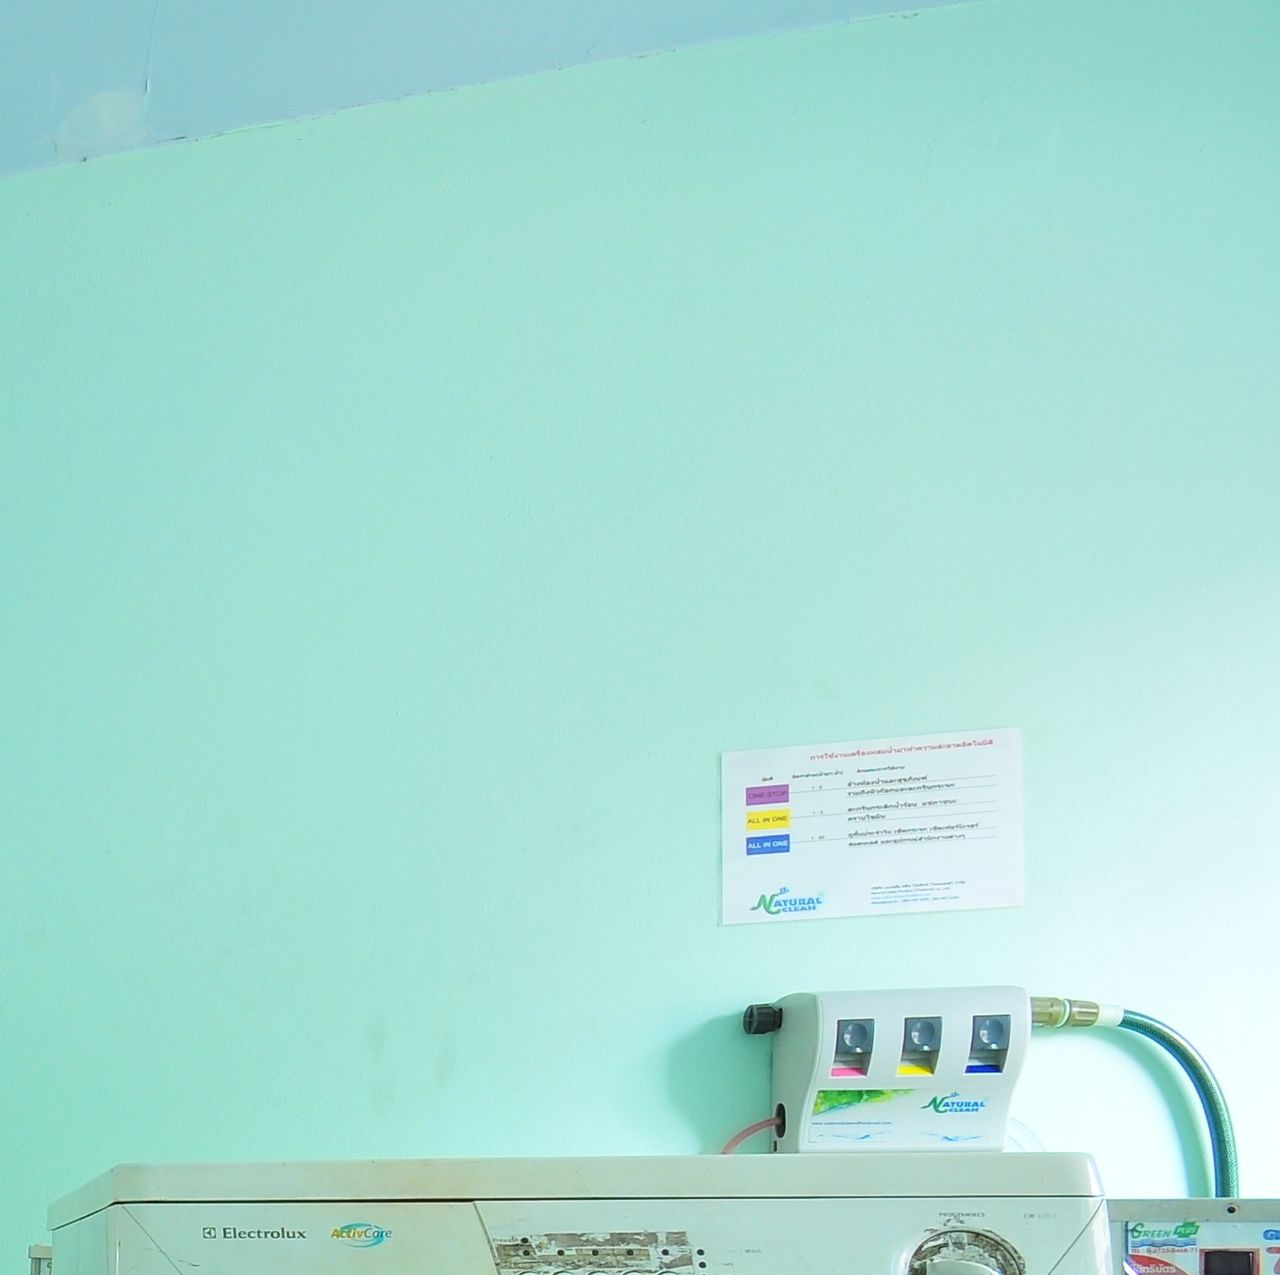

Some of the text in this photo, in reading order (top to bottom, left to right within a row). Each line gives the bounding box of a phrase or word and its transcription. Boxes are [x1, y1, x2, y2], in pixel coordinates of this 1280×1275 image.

[772, 815, 788, 823] ONE
[748, 842, 762, 850] ALL
[772, 840, 789, 848] ONE
[921, 1096, 986, 1113] NATURAL
[222, 1227, 392, 1239] Electrolux ActivCare
[1130, 1222, 1172, 1239] GREEN
